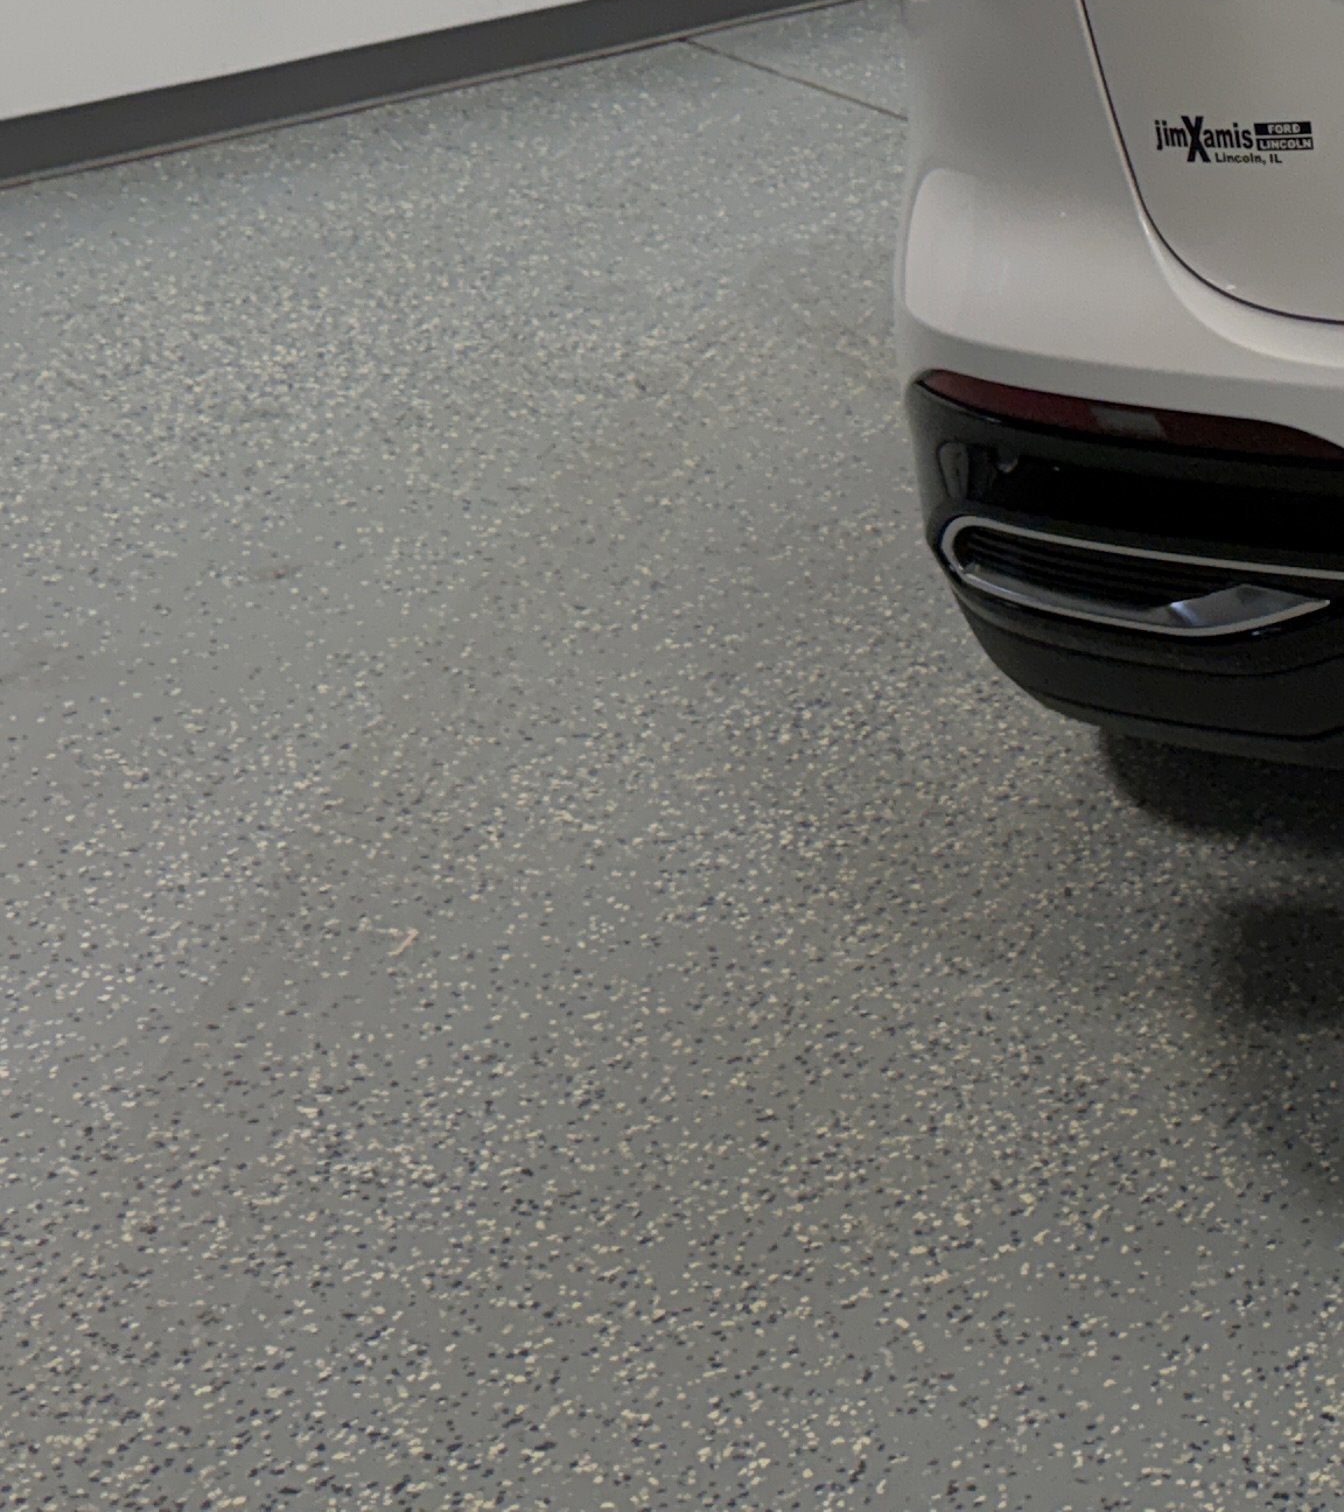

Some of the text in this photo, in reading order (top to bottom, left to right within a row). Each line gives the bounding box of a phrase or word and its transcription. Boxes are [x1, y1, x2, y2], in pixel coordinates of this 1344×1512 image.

[1266, 124, 1301, 135] FORD
[1154, 116, 1254, 163] jimXamis
[1258, 139, 1313, 150] LINCOLN
[1214, 151, 1283, 165] Lincoln, IL
